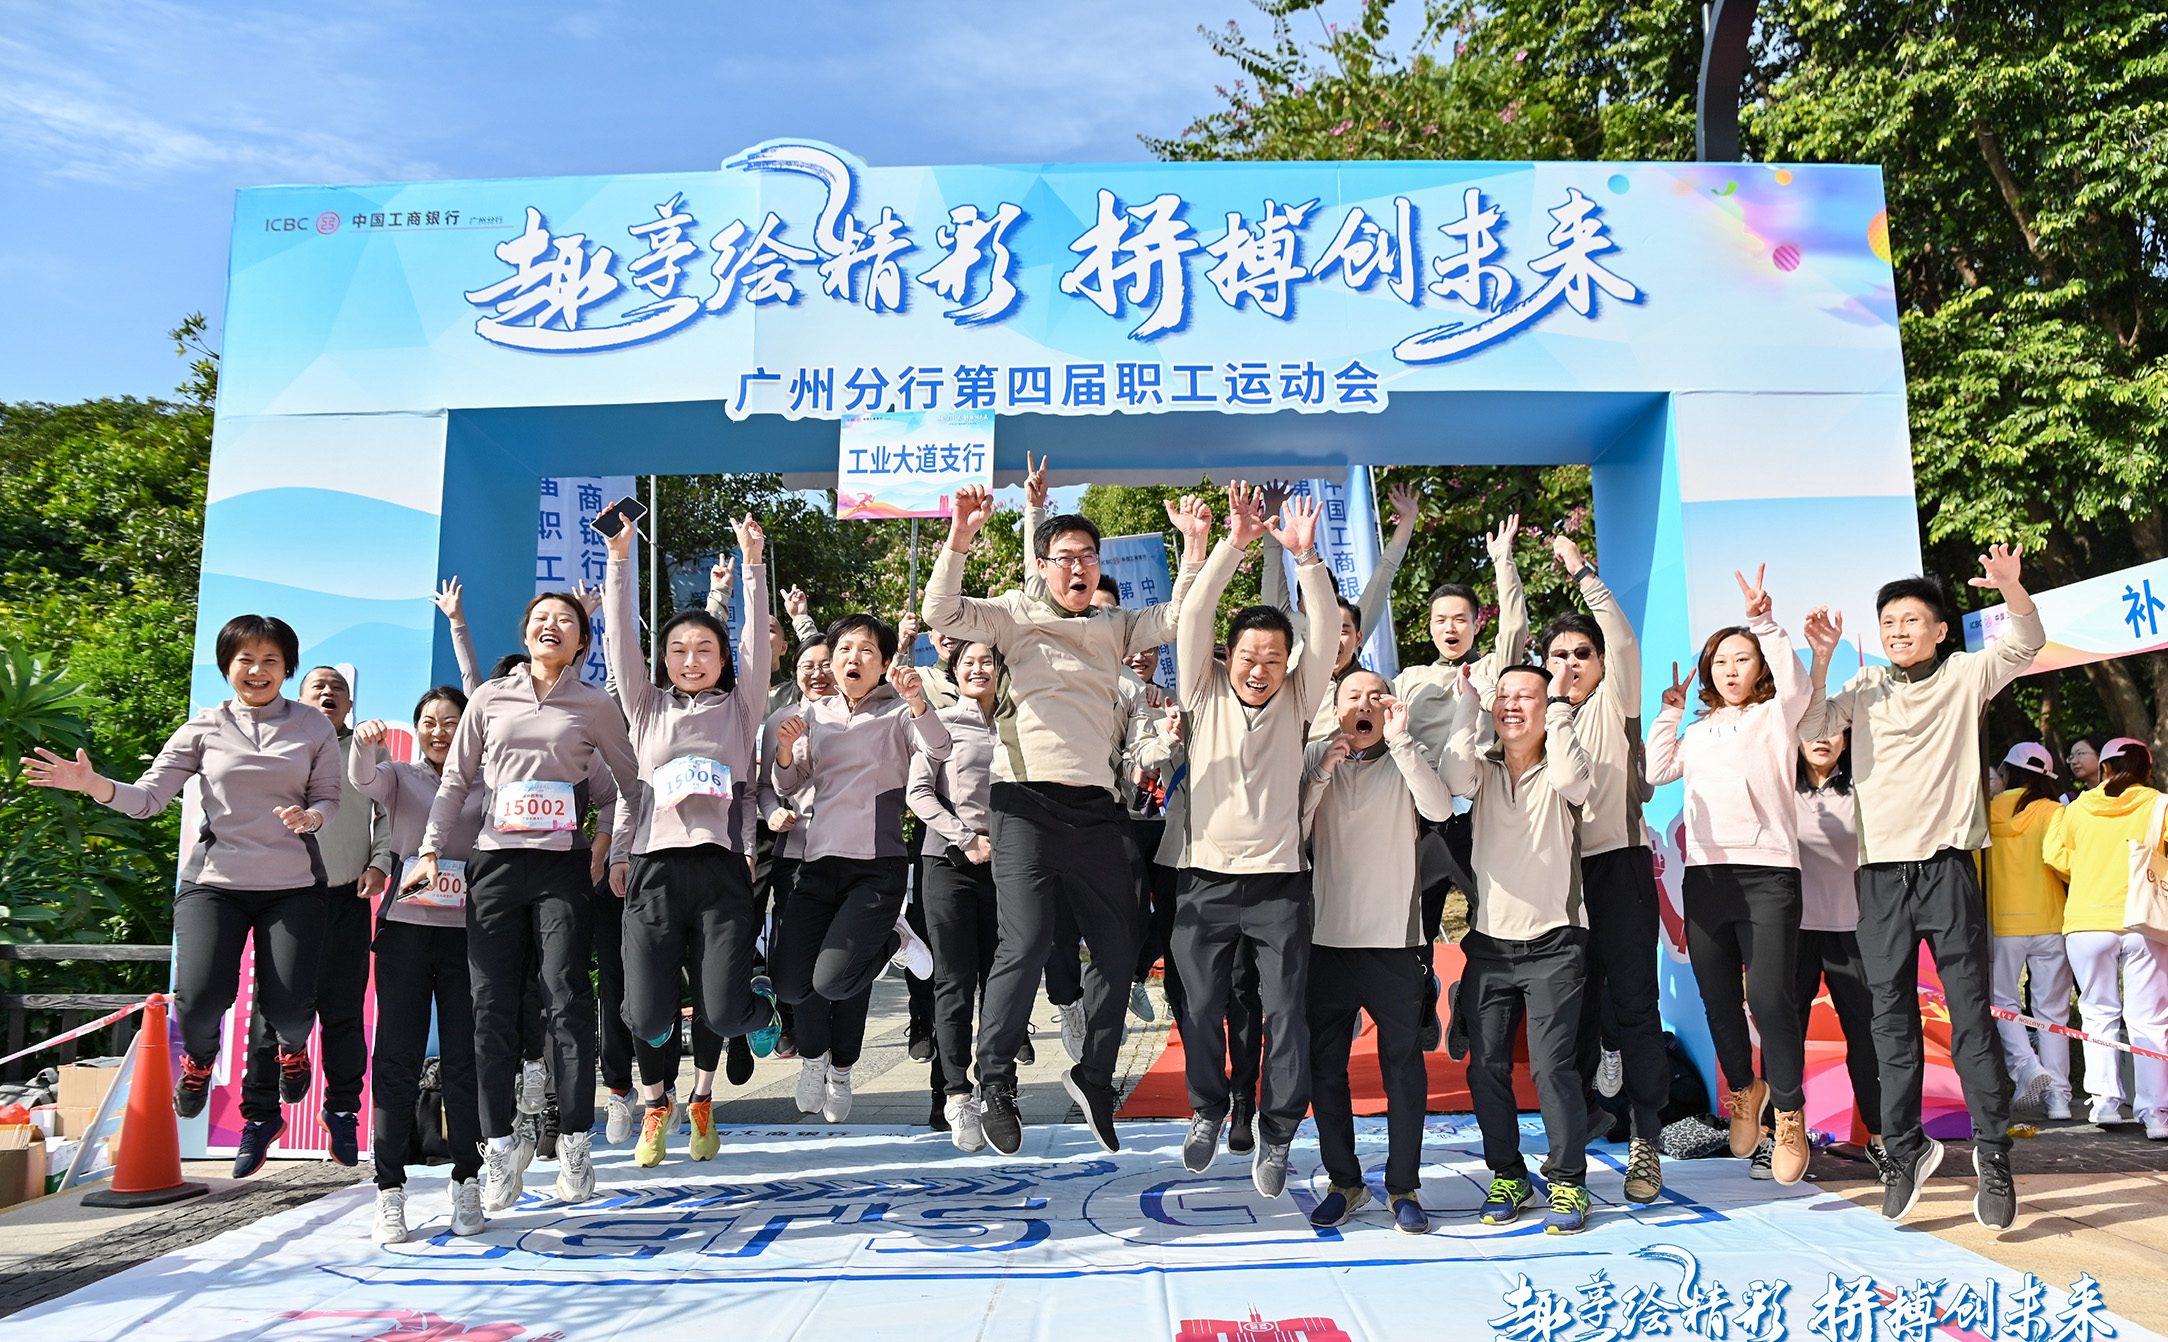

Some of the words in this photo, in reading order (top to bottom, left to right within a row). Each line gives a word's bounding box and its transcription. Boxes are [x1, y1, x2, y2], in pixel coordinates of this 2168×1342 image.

[265, 217, 309, 232] ICBC
[352, 210, 460, 228] 中国工商银行
[466, 145, 1024, 352] 趣享绘精彩
[1060, 187, 1643, 364] 拼搏创未来
[735, 361, 1380, 412] 广州分行第四届职工运动会
[847, 443, 985, 474] 工业大道支行
[2122, 579, 2166, 639] 补
[667, 768, 722, 796] 15006
[503, 798, 565, 817] 15002
[2018, 1017, 2046, 1029] CAUTION
